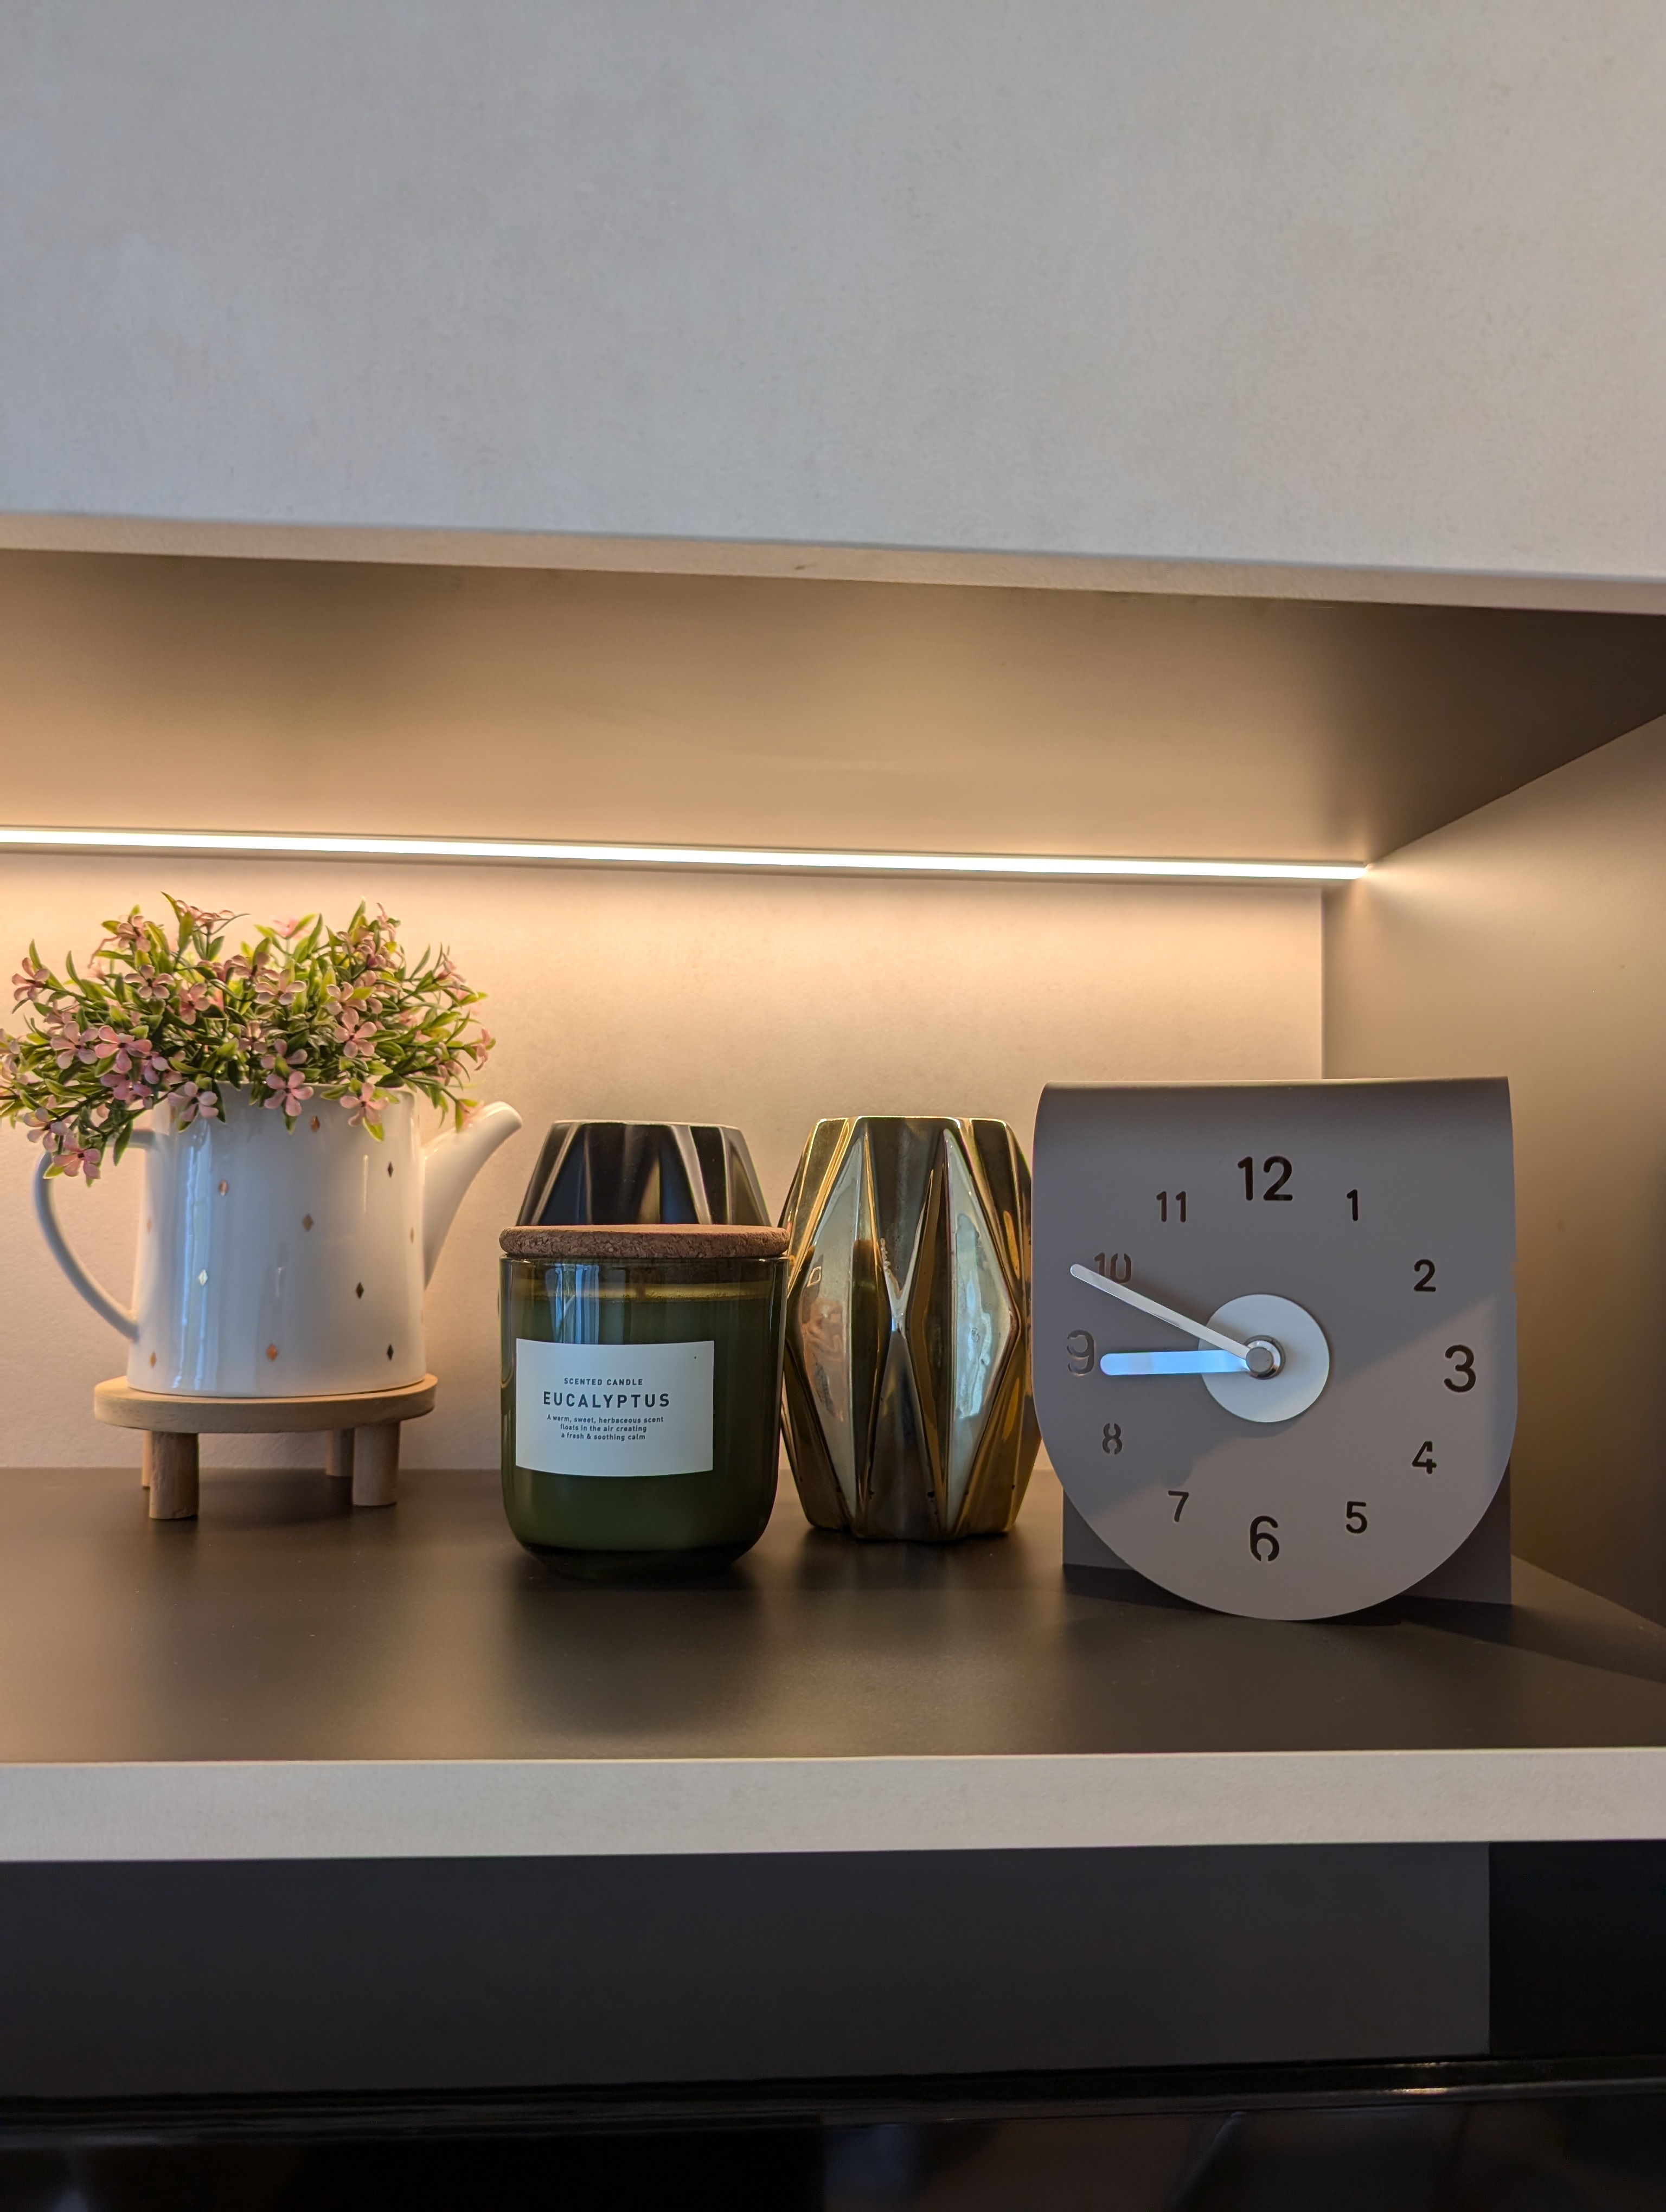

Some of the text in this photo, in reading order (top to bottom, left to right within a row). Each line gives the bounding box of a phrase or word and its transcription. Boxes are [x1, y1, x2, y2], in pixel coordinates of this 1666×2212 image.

[1237, 1156, 1293, 1201] 12
[1156, 1191, 1187, 1223] 11
[1345, 1189, 1359, 1221] 1
[1094, 1252, 1132, 1283] 10
[1413, 1259, 1437, 1293] 2
[1067, 1329, 1094, 1376] 9
[1444, 1344, 1477, 1393] 3
[564, 1378, 603, 1386] SCENTED
[543, 1391, 669, 1409] EUCALYPTUS
[1102, 1423, 1123, 1455] 8
[1411, 1441, 1438, 1474] 4
[1167, 1490, 1190, 1522] 7
[1345, 1501, 1368, 1534] 5
[1250, 1515, 1280, 1562] 6
